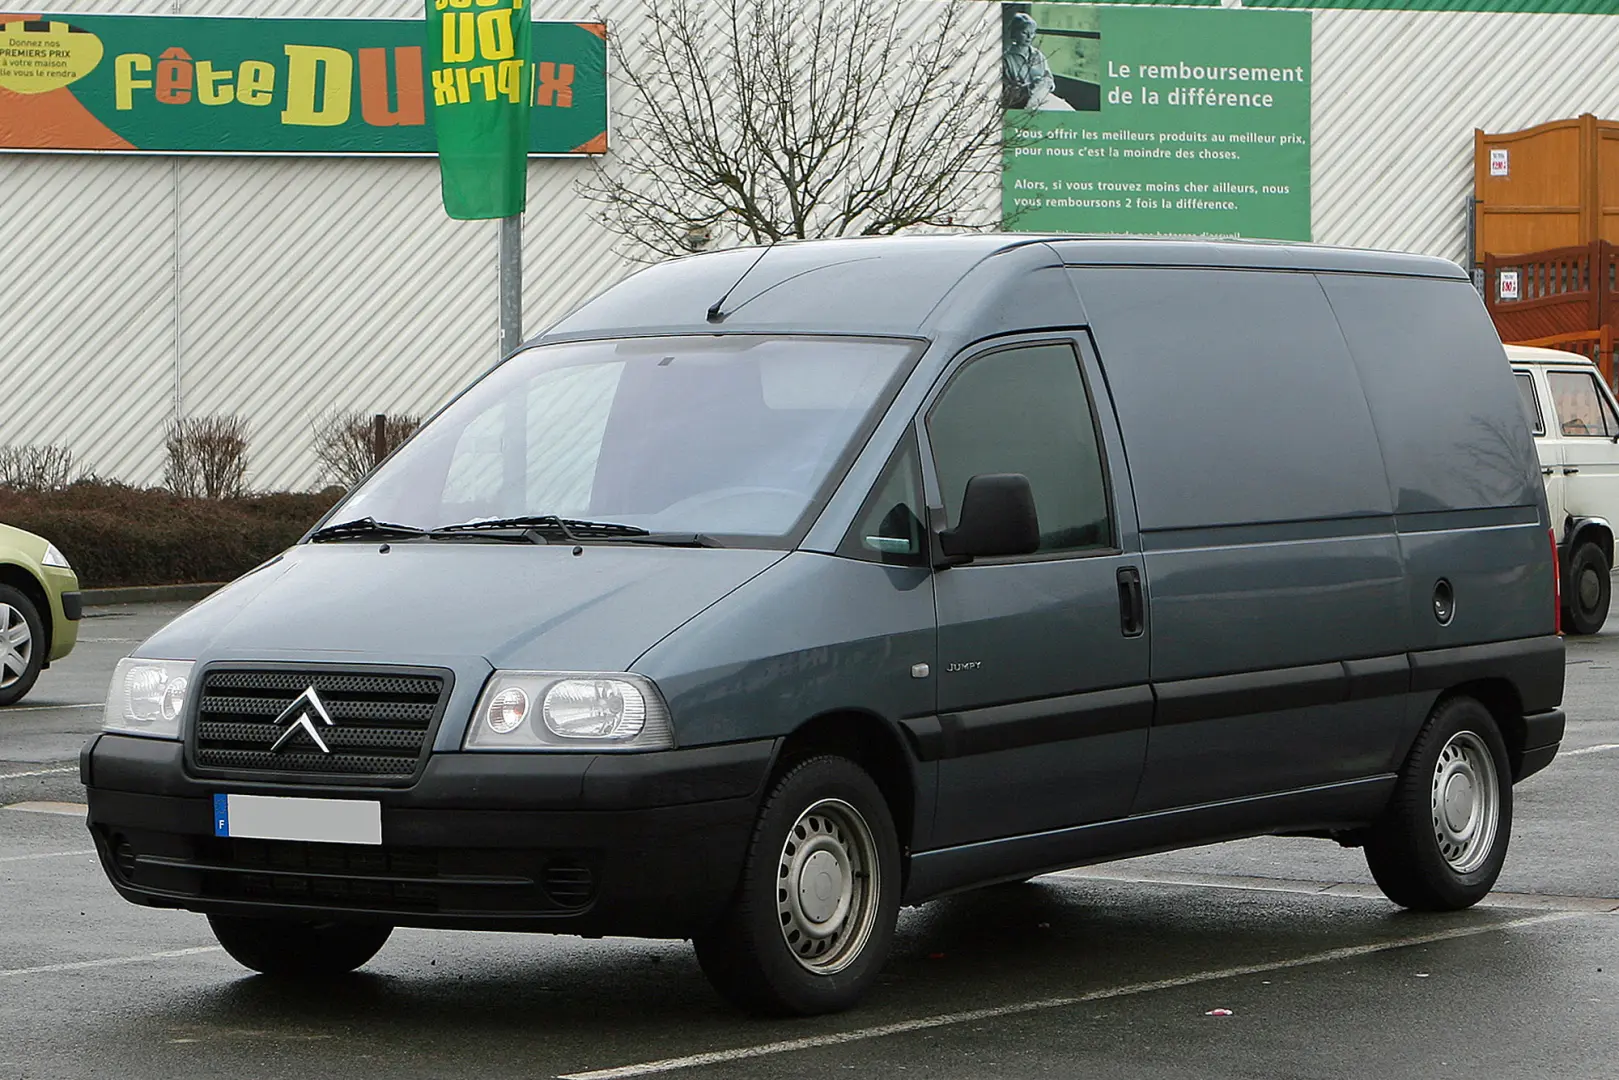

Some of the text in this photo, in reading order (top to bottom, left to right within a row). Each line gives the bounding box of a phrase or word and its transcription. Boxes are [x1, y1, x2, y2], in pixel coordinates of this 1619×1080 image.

[9, 38, 60, 48] Donnez nos
[0, 48, 71, 58] PREMIERS PRIX
[9, 59, 33, 67] votre
[34, 59, 67, 68] maison
[36, 69, 44, 77] le
[46, 70, 77, 78] rendra
[1108, 60, 1304, 82] Le remboursement
[281, 44, 425, 127] DU
[1108, 86, 1274, 107] de la différence
[1047, 128, 1078, 139] offrir
[1082, 129, 1098, 140] les
[1102, 129, 1155, 141] meilleurs
[1159, 131, 1208, 143] produits
[1211, 133, 1225, 142] au
[1229, 132, 1276, 143] meilleur
[1280, 133, 1306, 145] prix,
[1015, 146, 1240, 160] pour nous c'est la moindre des choses.
[1014, 179, 1290, 194] Alors, si vous trouvez moins cher ailleurs, nous
[1014, 197, 1238, 210] vous remboursons 2 fois la différence.
[946, 661, 982, 672] JUMPY
[219, 820, 225, 830] F
